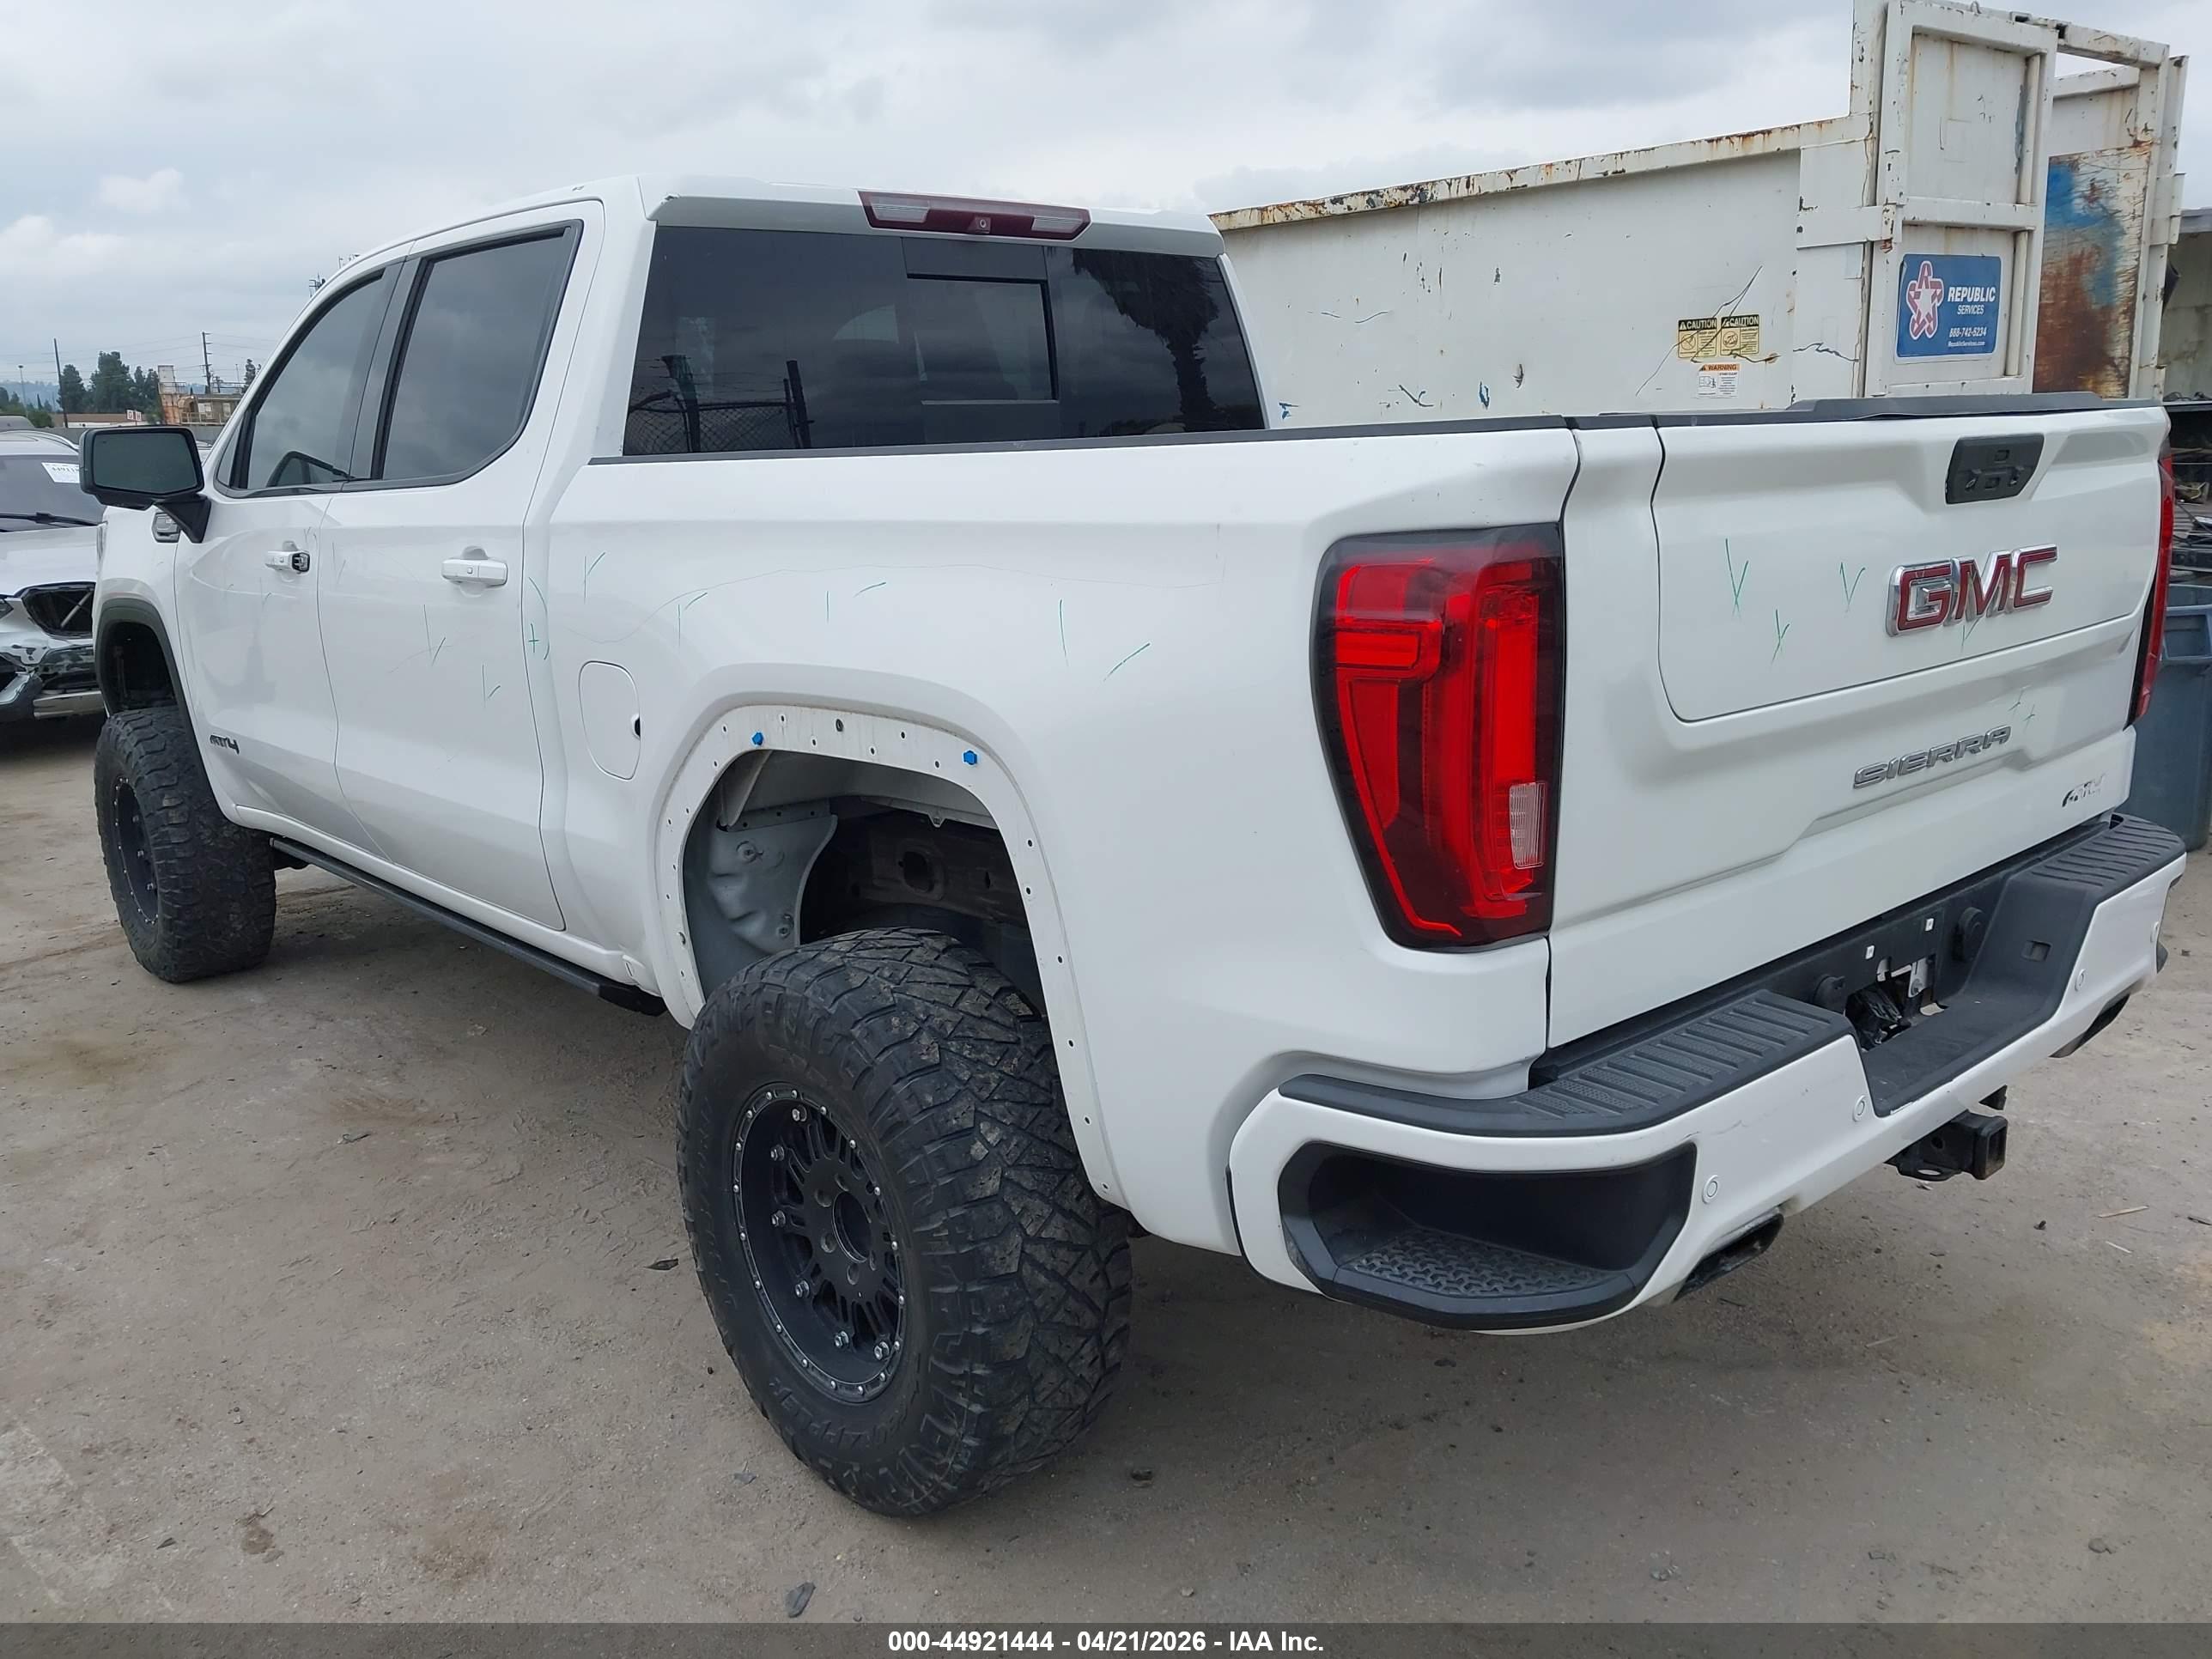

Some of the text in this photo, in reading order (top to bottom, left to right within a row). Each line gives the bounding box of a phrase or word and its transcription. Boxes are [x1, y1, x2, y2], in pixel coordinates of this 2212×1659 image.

[1947, 286, 1996, 302] REPUBLIC
[1957, 304, 1984, 315] SERVICES
[1686, 319, 1717, 330] CAUTION
[1729, 315, 1759, 326] CAUTION
[1885, 543, 2058, 638] GMC
[1853, 726, 2012, 790] SIERRA
